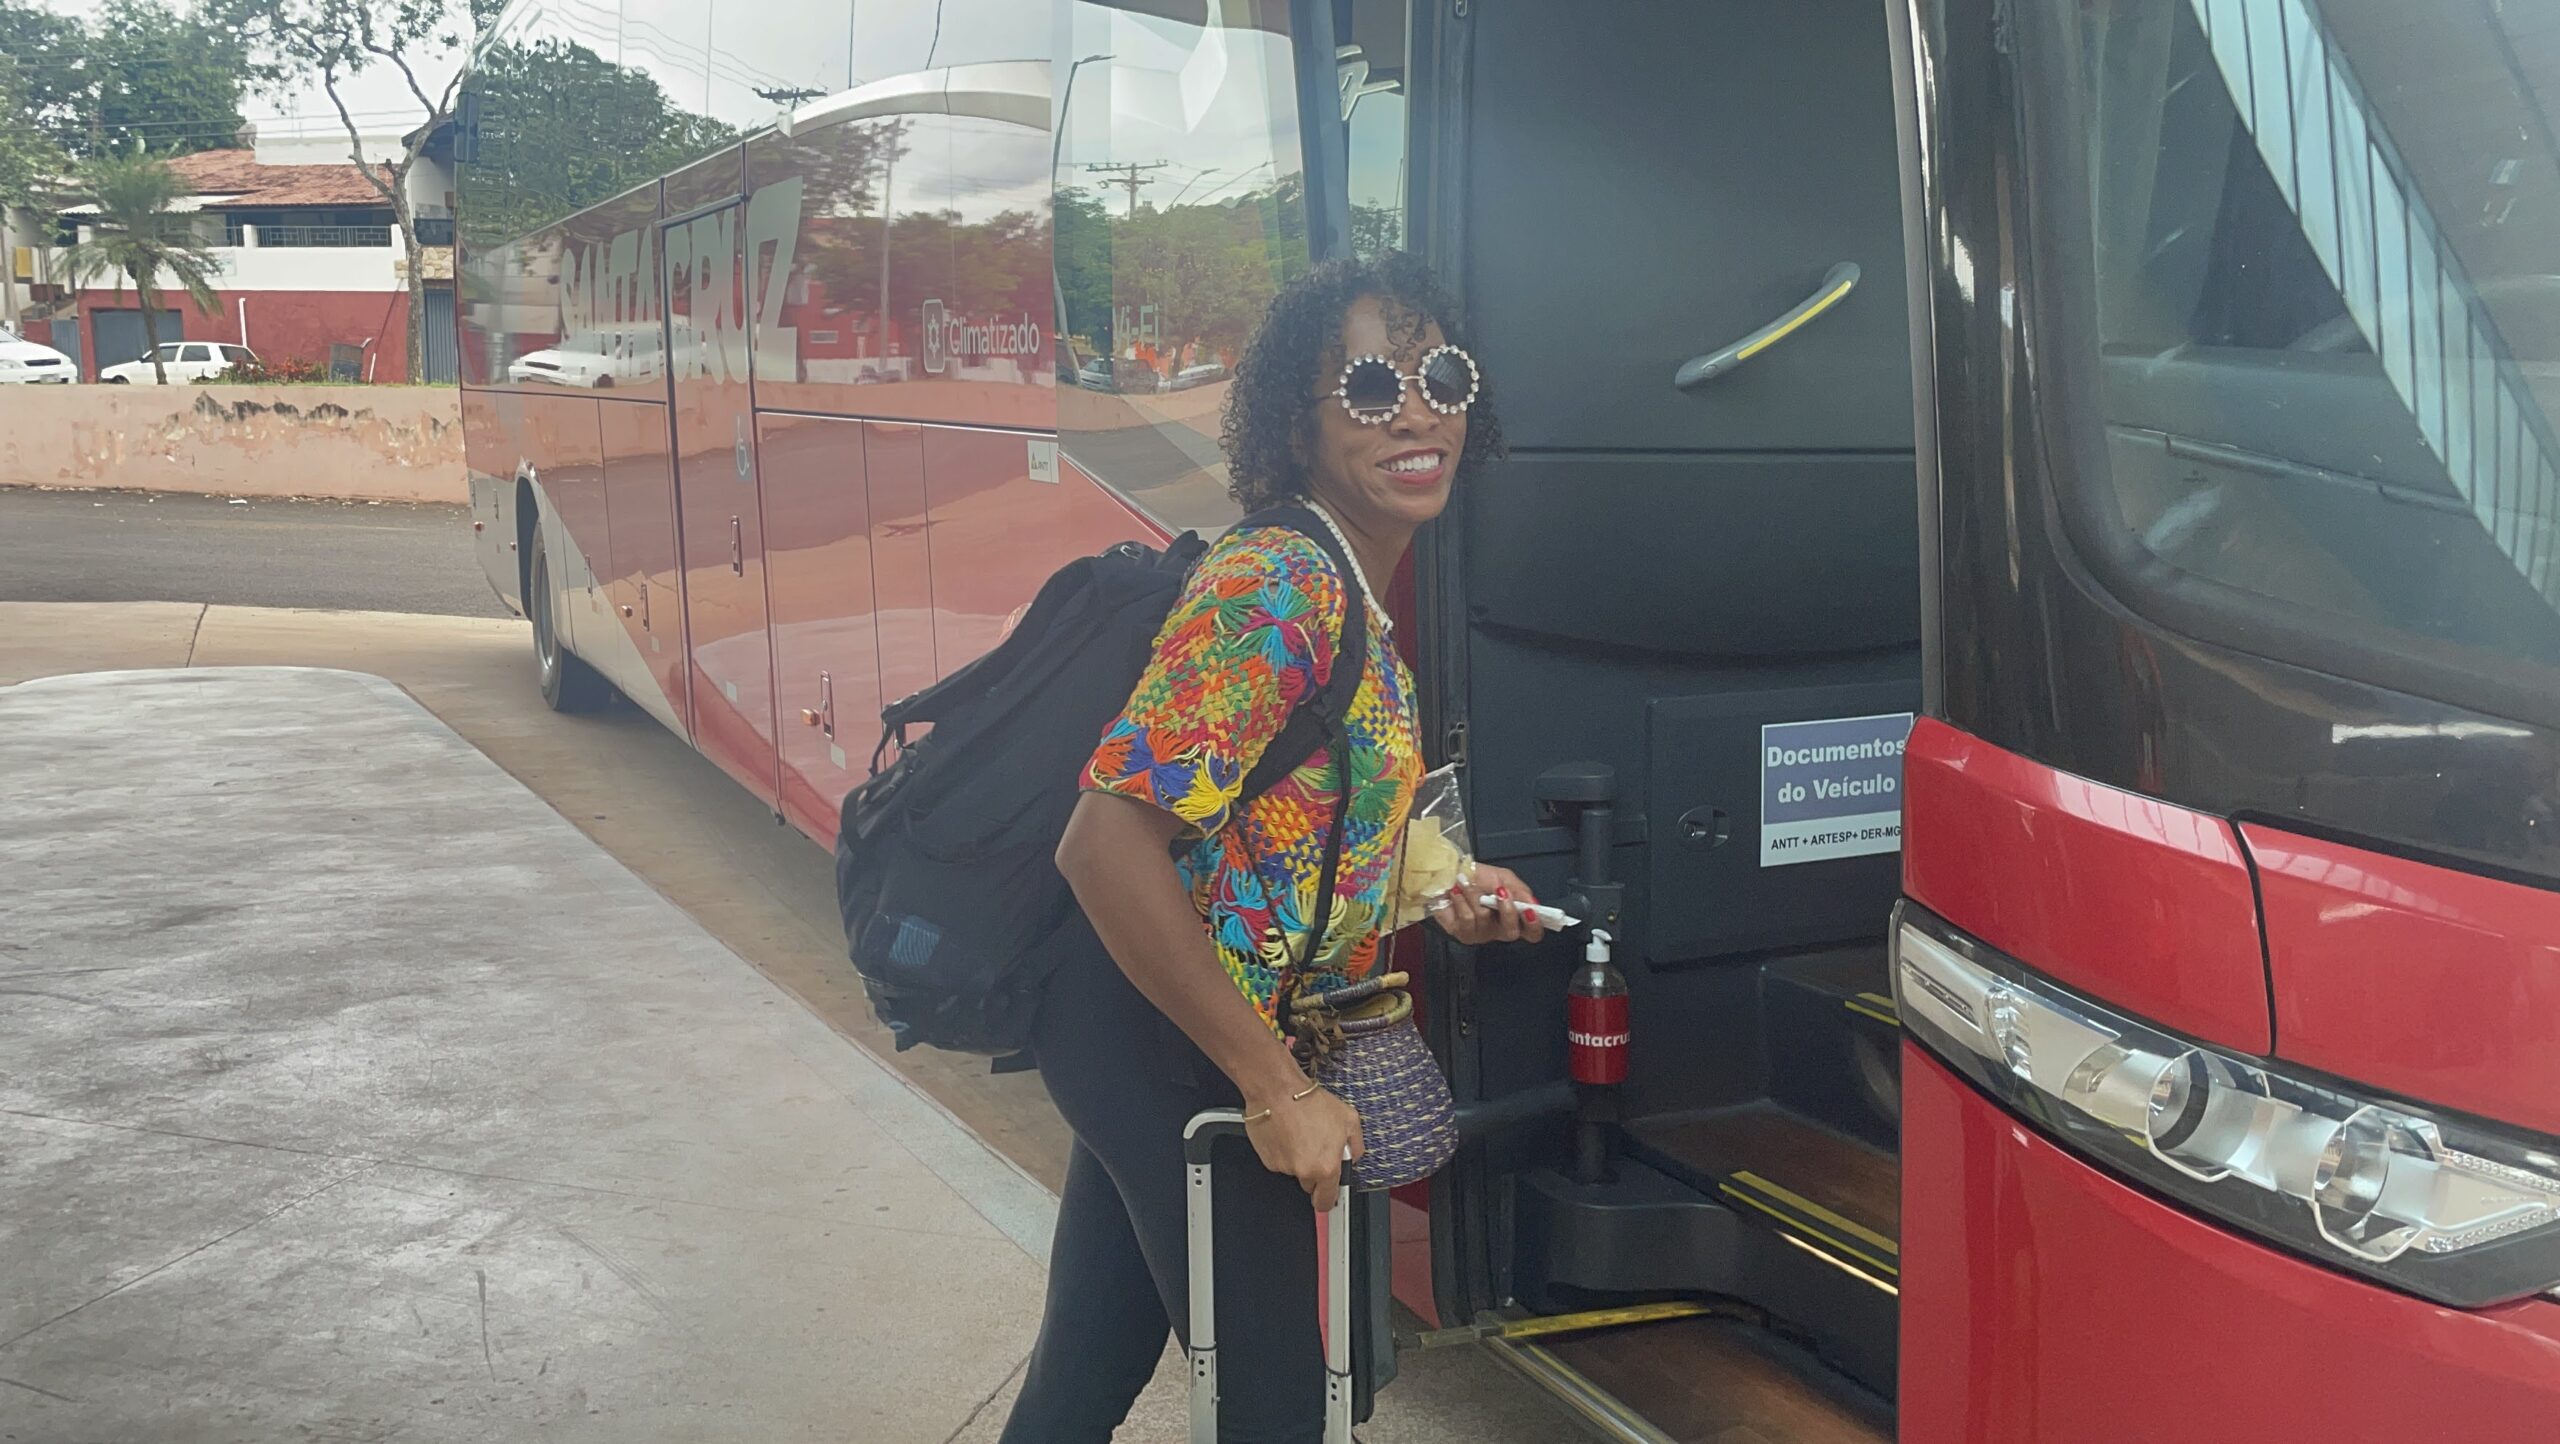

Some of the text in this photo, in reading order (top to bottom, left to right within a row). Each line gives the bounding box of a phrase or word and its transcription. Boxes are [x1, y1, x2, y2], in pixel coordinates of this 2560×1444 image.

[560, 176, 803, 388] SANTA CRUZ
[949, 312, 1040, 355] Climatizado
[1767, 737, 1906, 768] Documentos
[1777, 773, 1896, 804] do Veículo
[1771, 836, 1800, 851] ANTT
[1861, 825, 1901, 841] DER-MG
